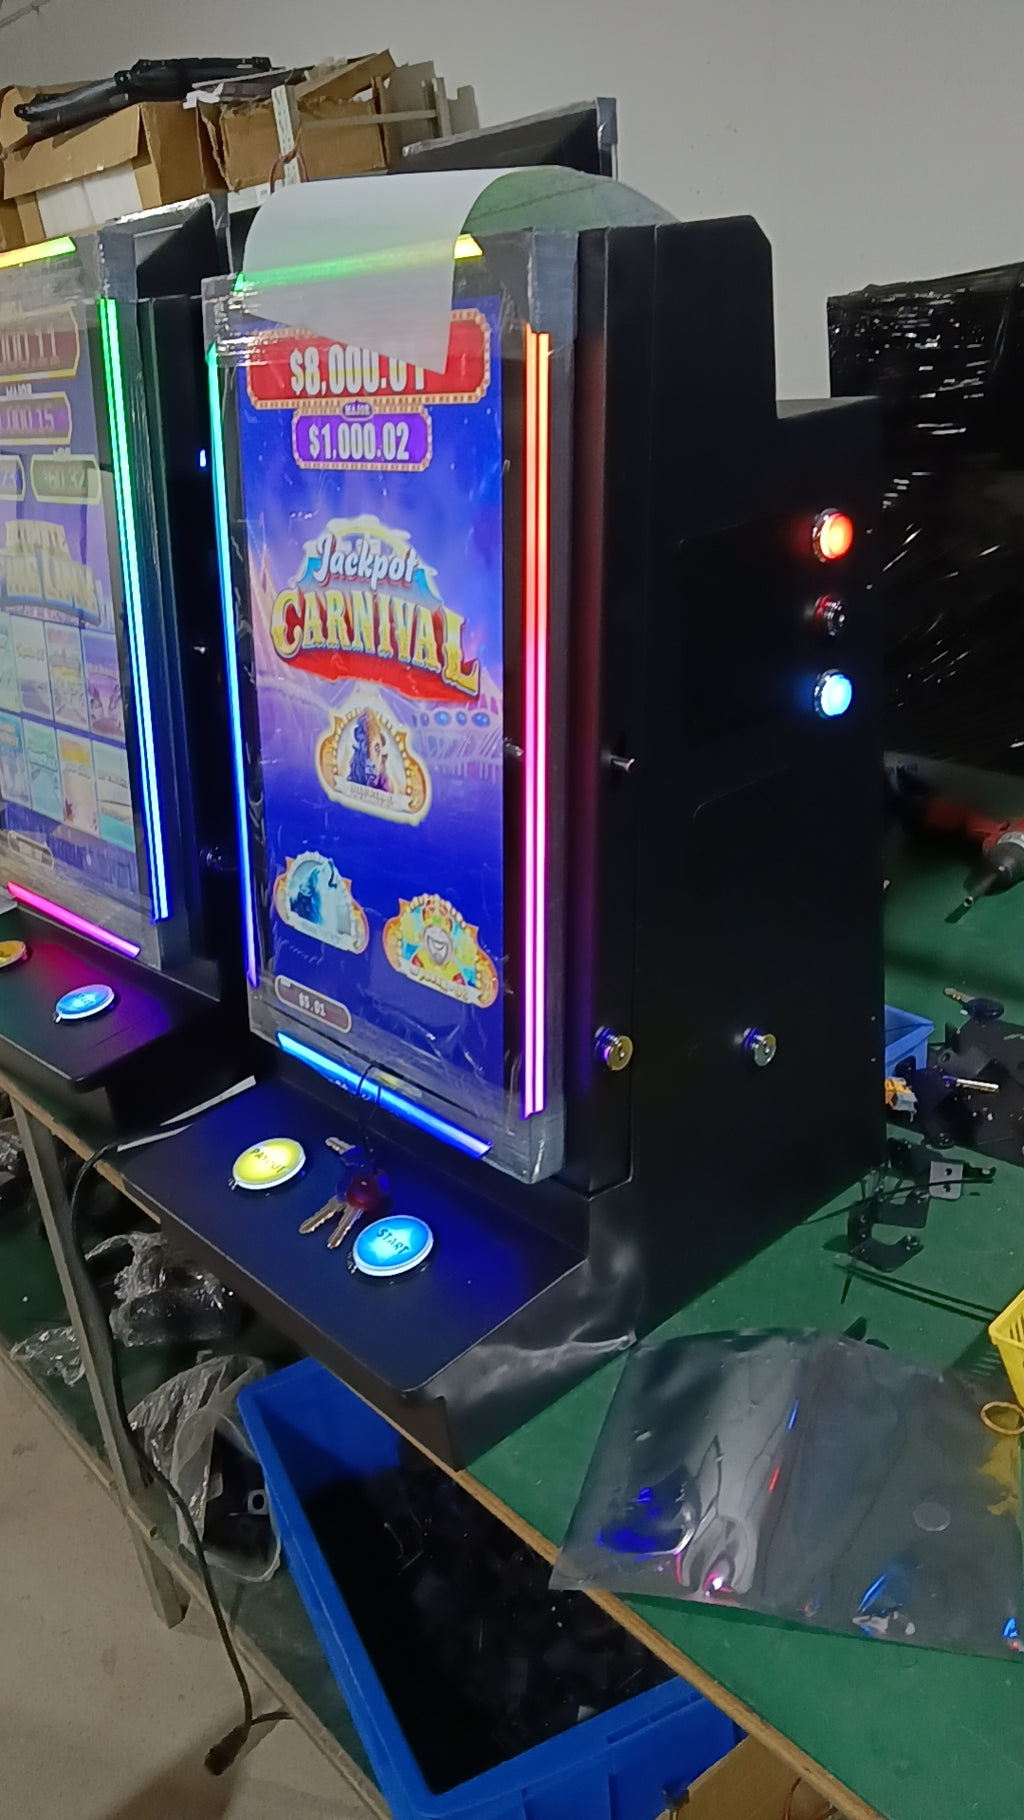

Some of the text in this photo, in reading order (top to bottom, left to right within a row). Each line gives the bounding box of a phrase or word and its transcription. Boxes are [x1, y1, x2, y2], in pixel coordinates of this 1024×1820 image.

[309, 422, 409, 461] $1,000.02
[313, 532, 419, 590] Jackpot
[271, 587, 480, 696] CARNIVAL
[377, 1228, 410, 1255] START
